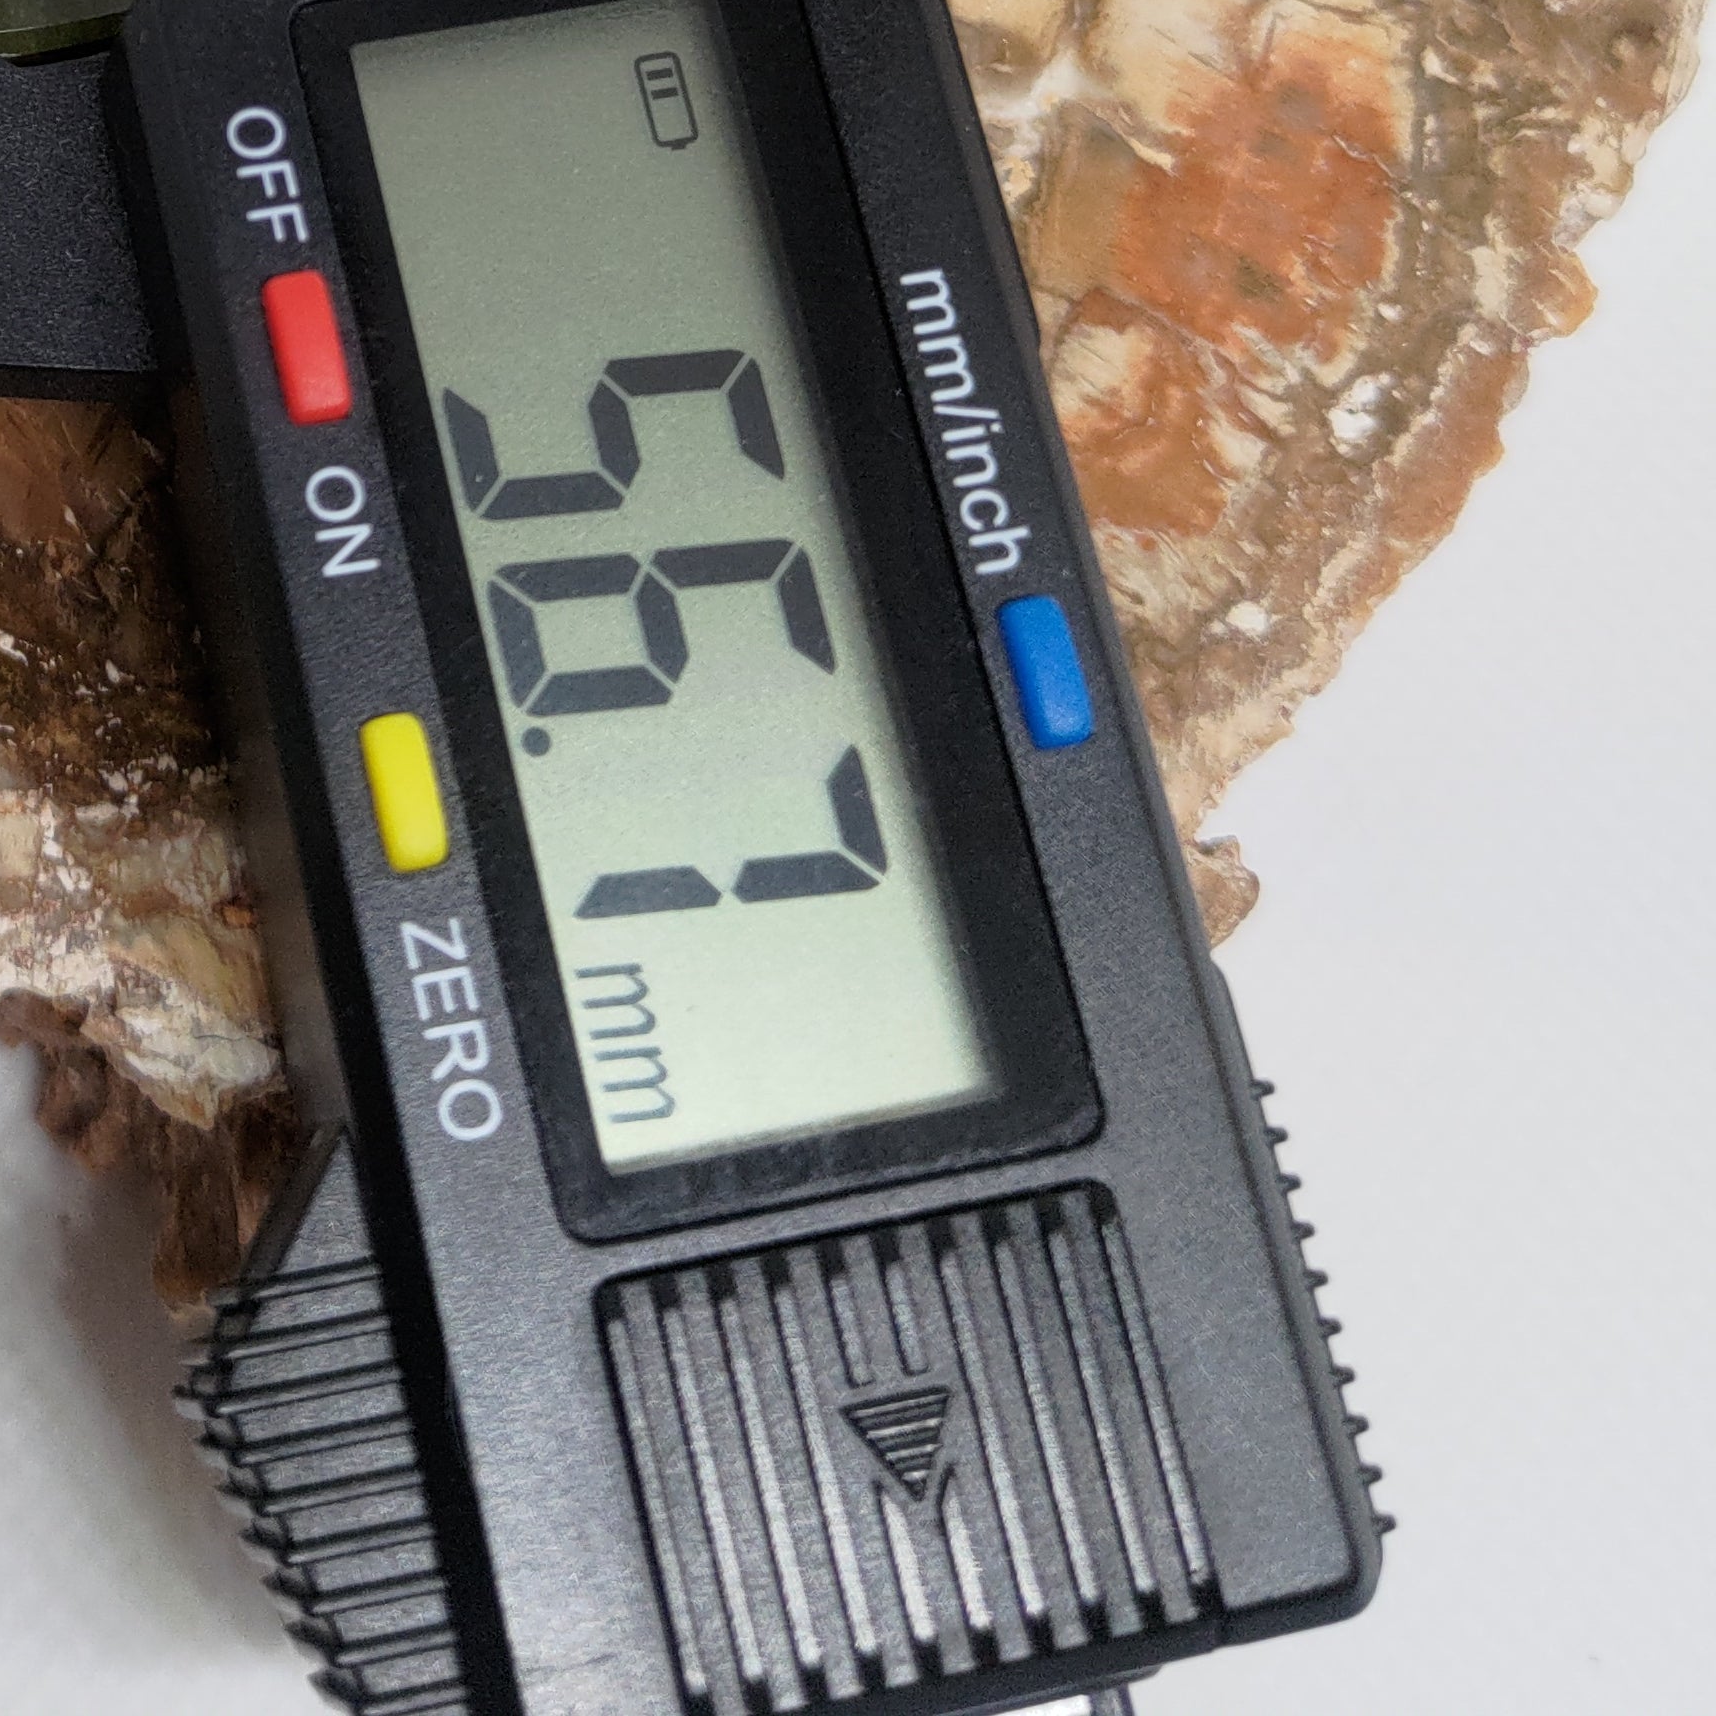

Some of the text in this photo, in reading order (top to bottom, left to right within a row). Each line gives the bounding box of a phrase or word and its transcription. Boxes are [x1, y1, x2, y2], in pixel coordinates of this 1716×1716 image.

[225, 105, 310, 245] OFF
[303, 464, 378, 579] ON
[899, 267, 1026, 578] mm/inch
[442, 346, 888, 1123] 56.7 mm
[398, 914, 504, 1143] ZERO
